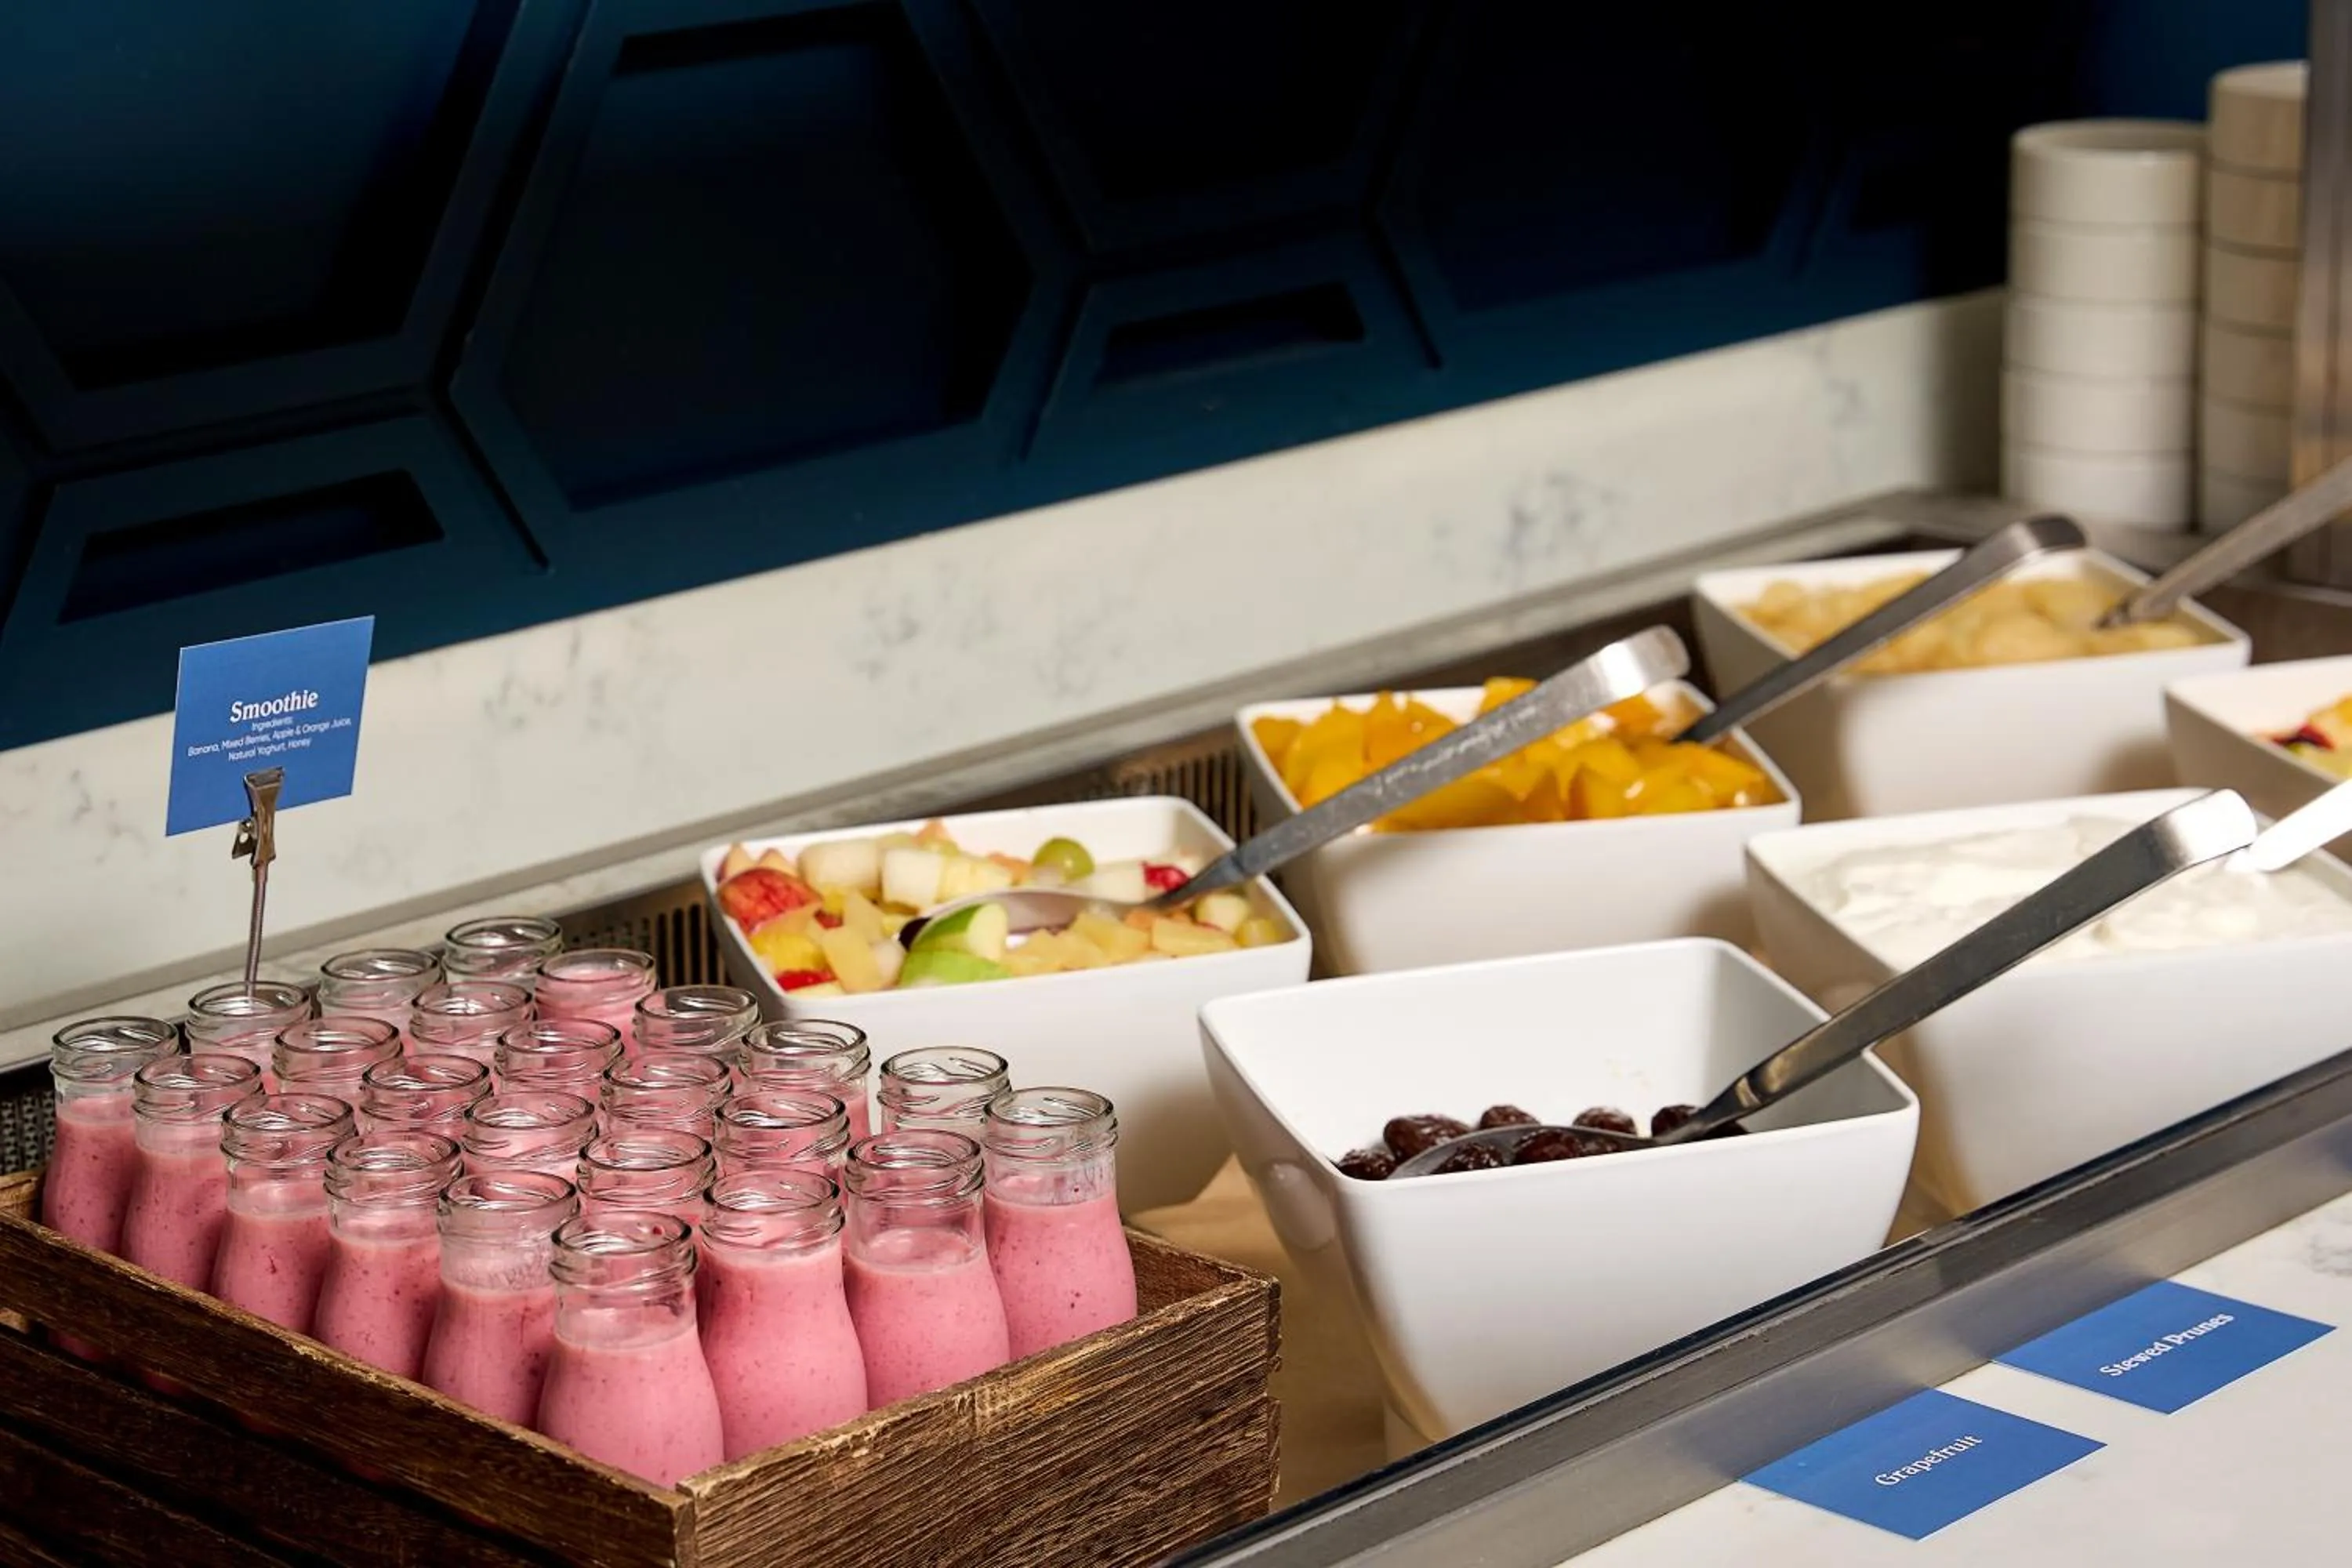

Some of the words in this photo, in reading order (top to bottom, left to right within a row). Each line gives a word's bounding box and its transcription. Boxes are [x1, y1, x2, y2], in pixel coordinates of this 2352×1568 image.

[230, 690, 318, 723] Smoothie
[272, 729, 294, 740] Apple
[295, 724, 302, 735] &
[302, 721, 330, 734] Orange
[227, 746, 256, 762] Natural
[2099, 1341, 2173, 1377] Stewed
[2161, 1313, 2234, 1345] Prunes
[1875, 1435, 1983, 1486] Grapefruit
